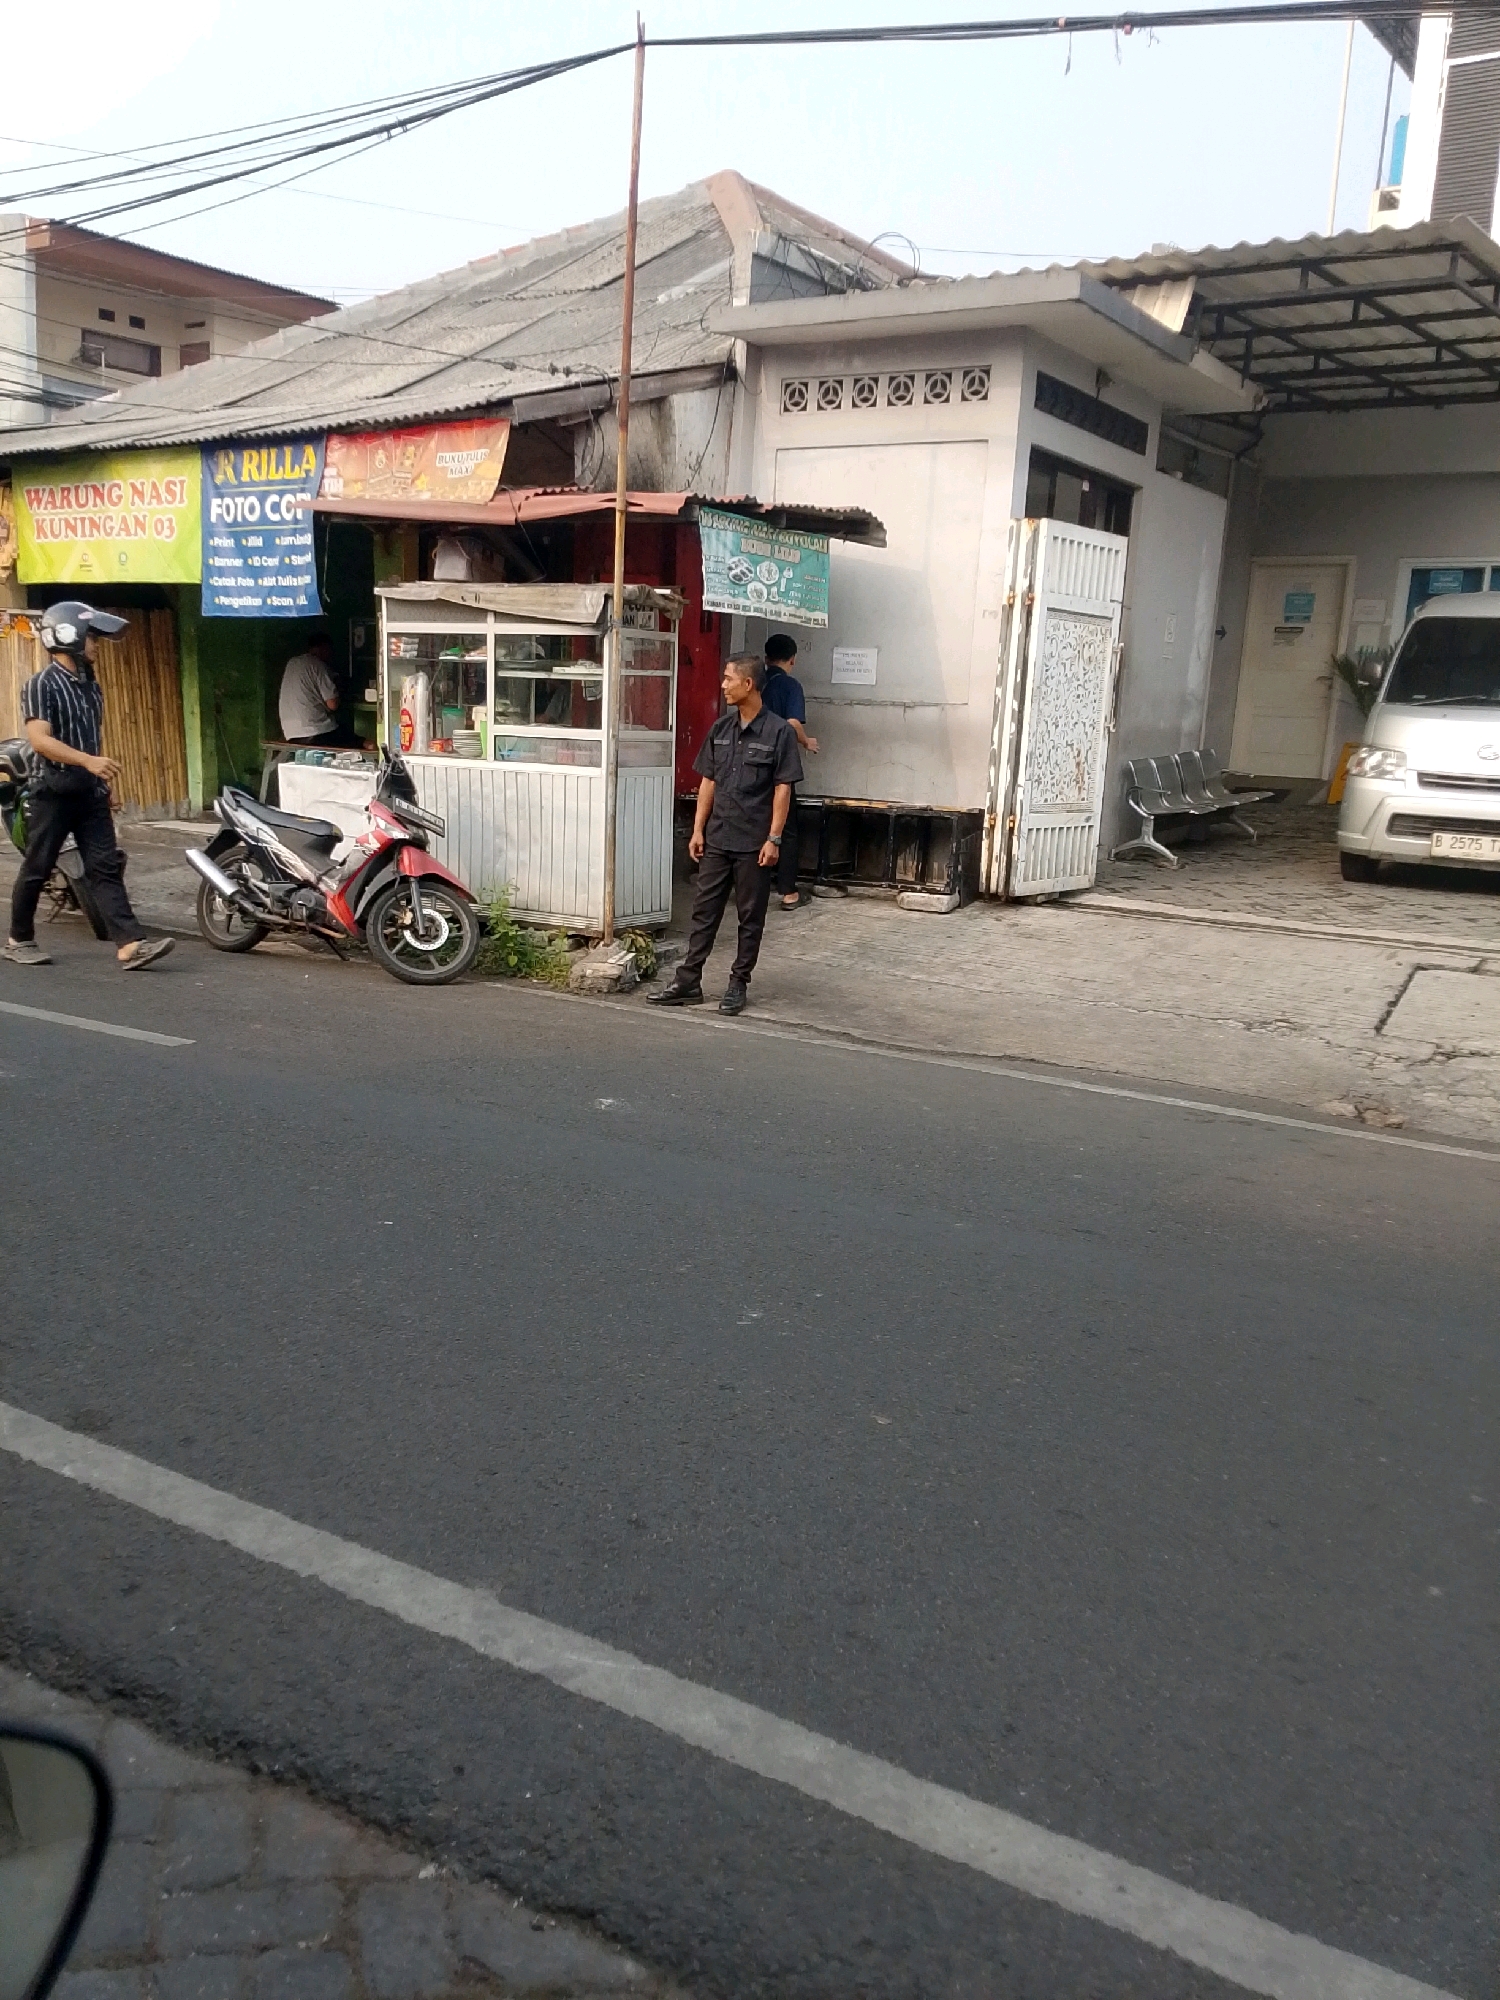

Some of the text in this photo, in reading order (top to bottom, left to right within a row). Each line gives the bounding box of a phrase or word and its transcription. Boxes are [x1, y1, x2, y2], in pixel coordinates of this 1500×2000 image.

[241, 444, 317, 482] RILLA
[25, 479, 187, 511] WARUNG NASI
[210, 493, 311, 523] FOTO COP
[35, 514, 176, 540] KUNINGAN 03
[213, 536, 235, 548] Print
[213, 556, 244, 567] Banner
[277, 575, 298, 586] Tulis
[272, 596, 294, 606] Scan
[1434, 835, 1500, 853] B 2575 T
